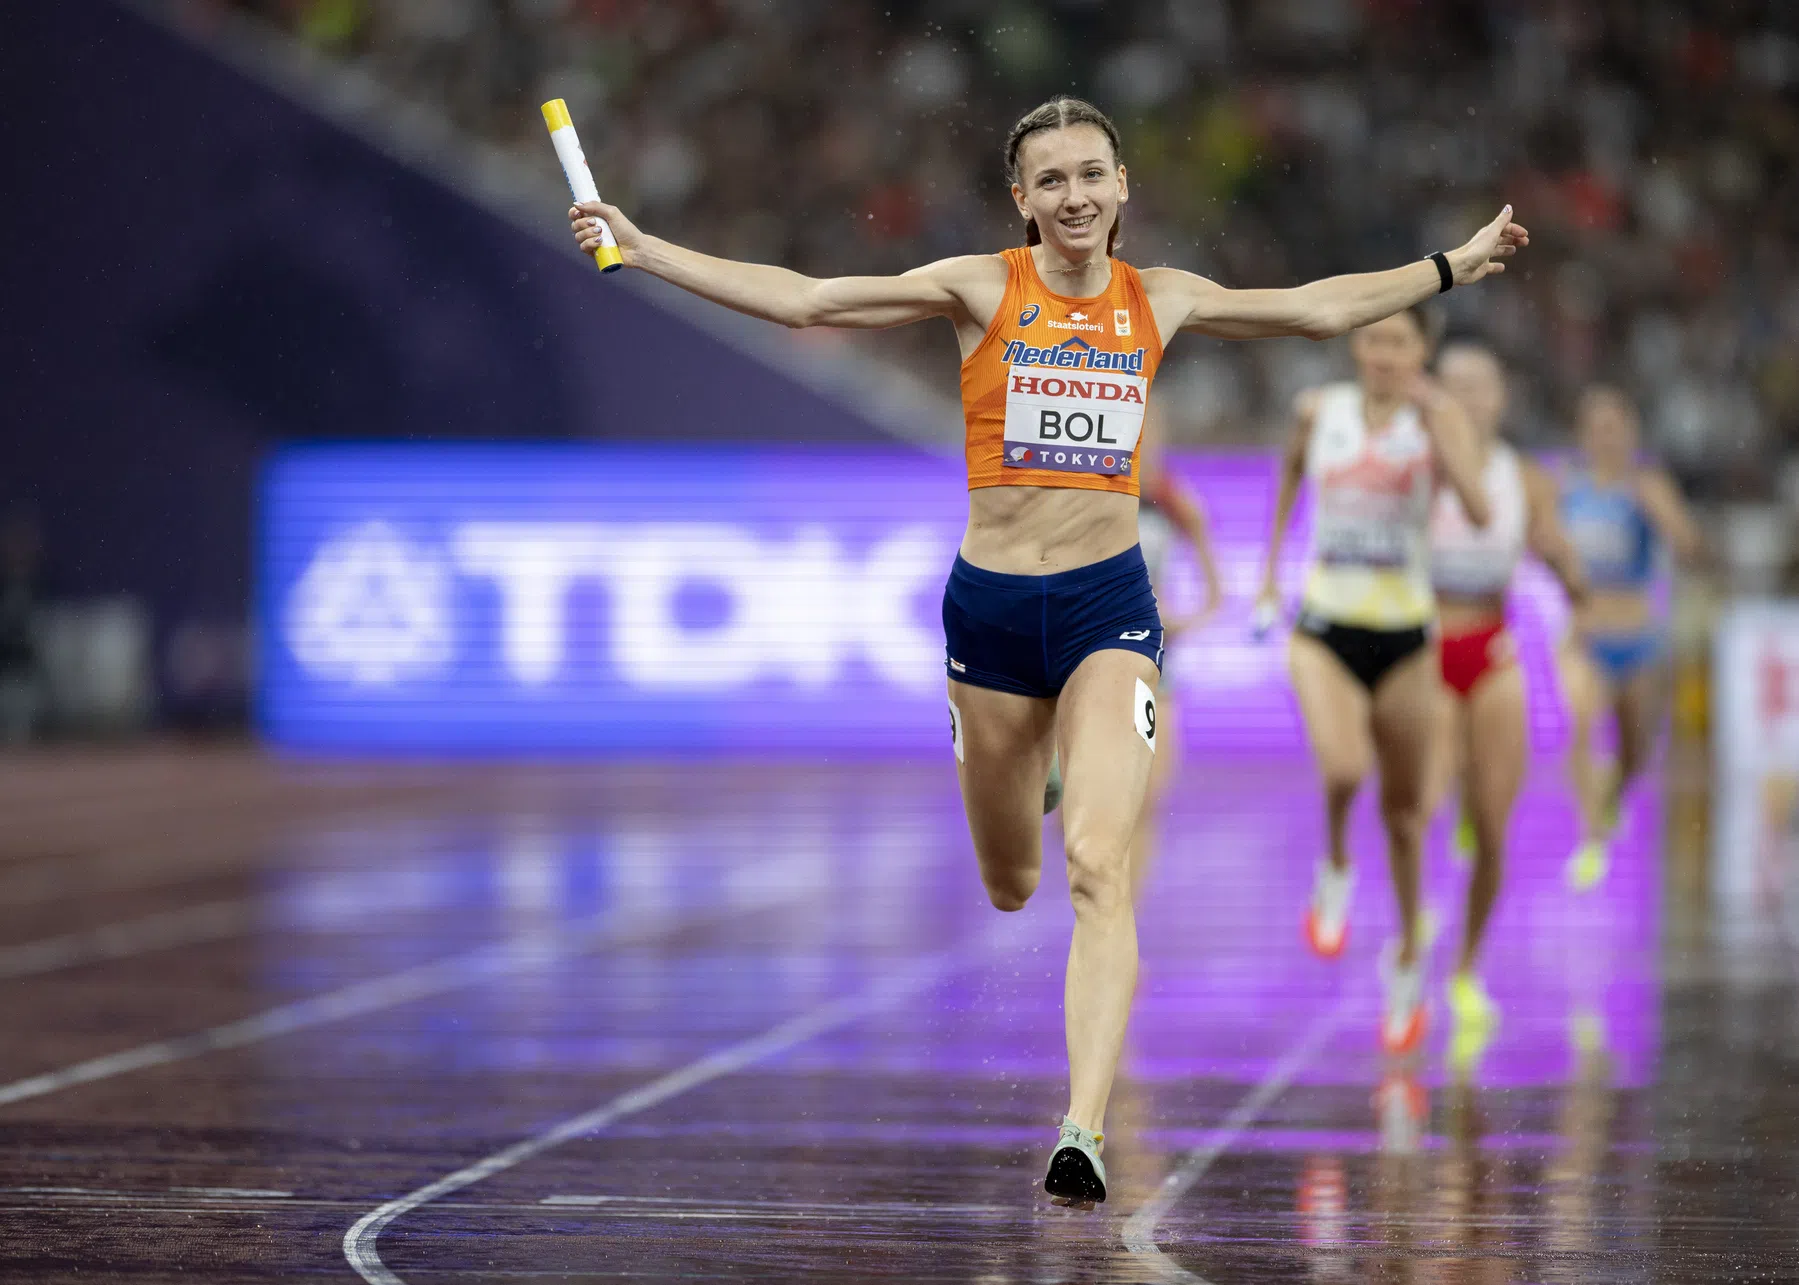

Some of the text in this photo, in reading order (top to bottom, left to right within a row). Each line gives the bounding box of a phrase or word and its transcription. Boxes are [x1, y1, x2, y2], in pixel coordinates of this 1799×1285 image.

[1047, 320, 1104, 333] Staatsloterij
[1011, 375, 1144, 404] HONDA
[1039, 410, 1117, 444] BOL
[454, 522, 946, 687] TDK
[1145, 700, 1156, 739] 9
